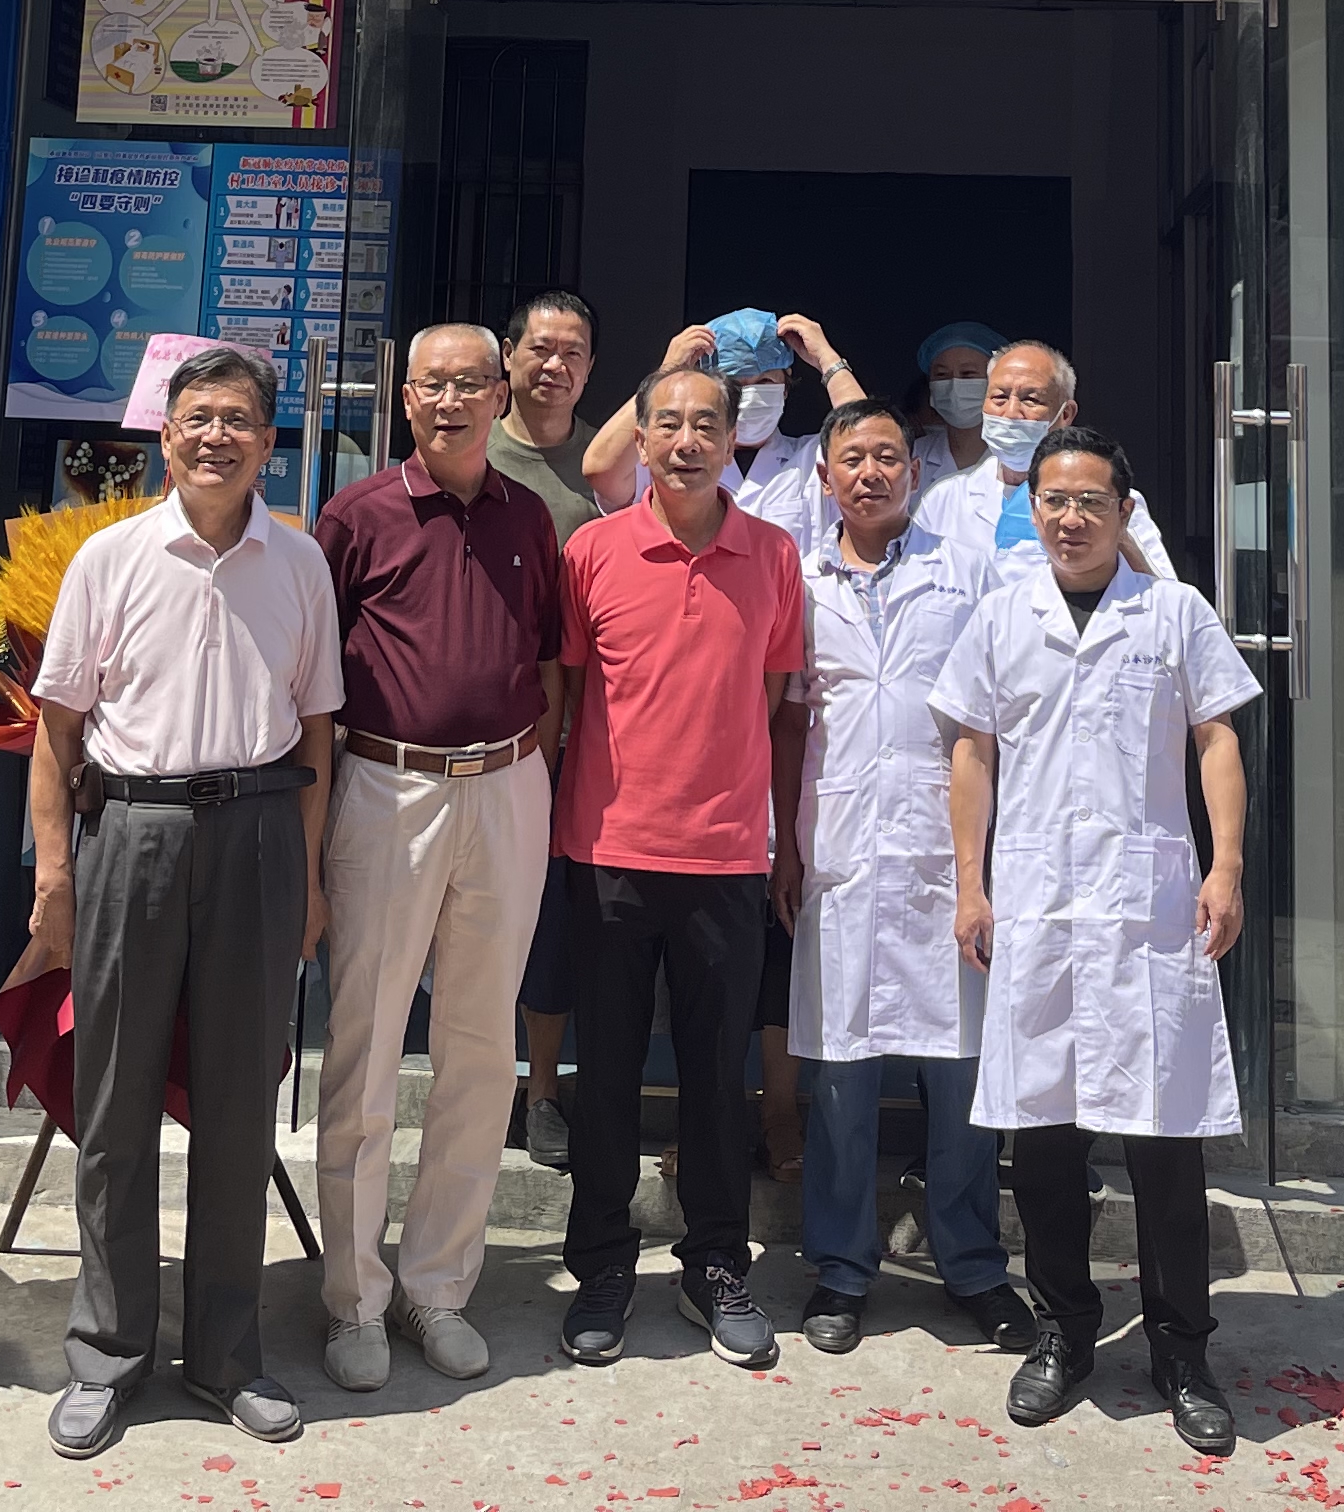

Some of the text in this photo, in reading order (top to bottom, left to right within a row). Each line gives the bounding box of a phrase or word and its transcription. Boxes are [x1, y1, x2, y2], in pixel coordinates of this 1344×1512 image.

[56, 164, 181, 188] 接诊和疫情防控
[260, 456, 289, 478] 毒
